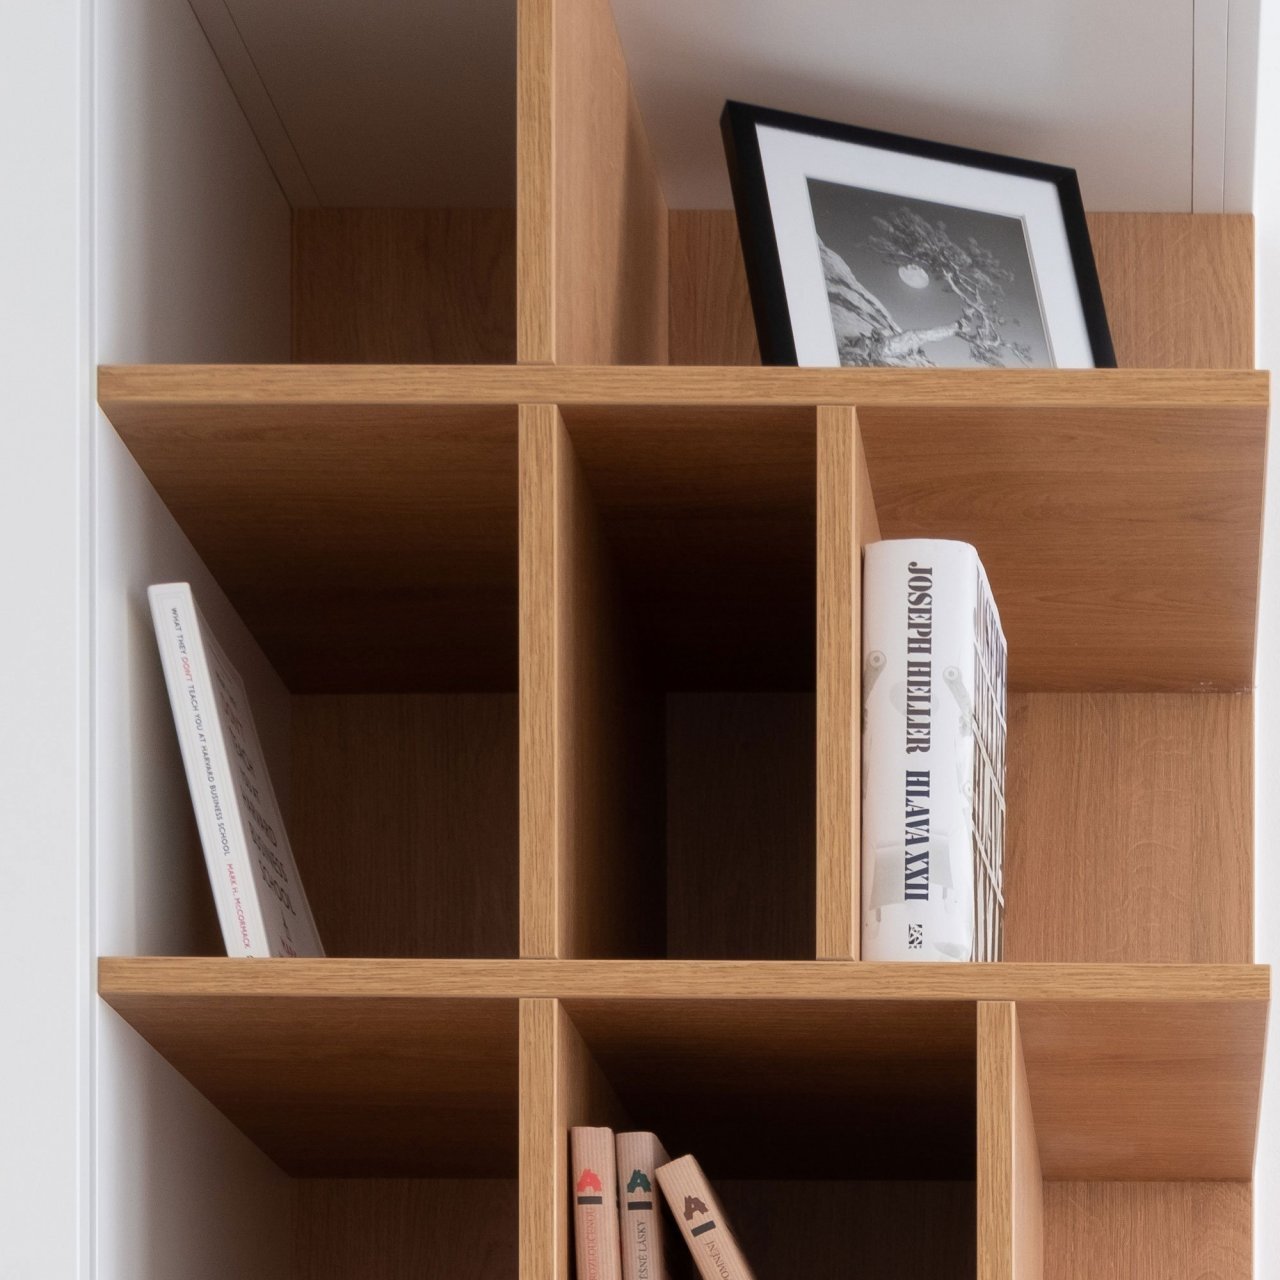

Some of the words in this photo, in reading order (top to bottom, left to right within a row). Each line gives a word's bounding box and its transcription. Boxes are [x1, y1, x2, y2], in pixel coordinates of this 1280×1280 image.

[170, 606, 182, 632] WHAT
[907, 561, 932, 654] JOSEPH
[176, 633, 187, 655] THEY
[187, 684, 199, 712] TEACH
[905, 660, 931, 754] HELLER
[193, 713, 204, 731] YOU
[197, 732, 206, 743] AT
[200, 744, 215, 783] HARVARD
[209, 784, 223, 821] BUSINESS
[905, 769, 930, 846] HLAVA
[216, 821, 231, 857] SCHOOL
[226, 862, 238, 888] MARK
[904, 850, 929, 901] XXII
[634, 1218, 647, 1252] LÁSKY
